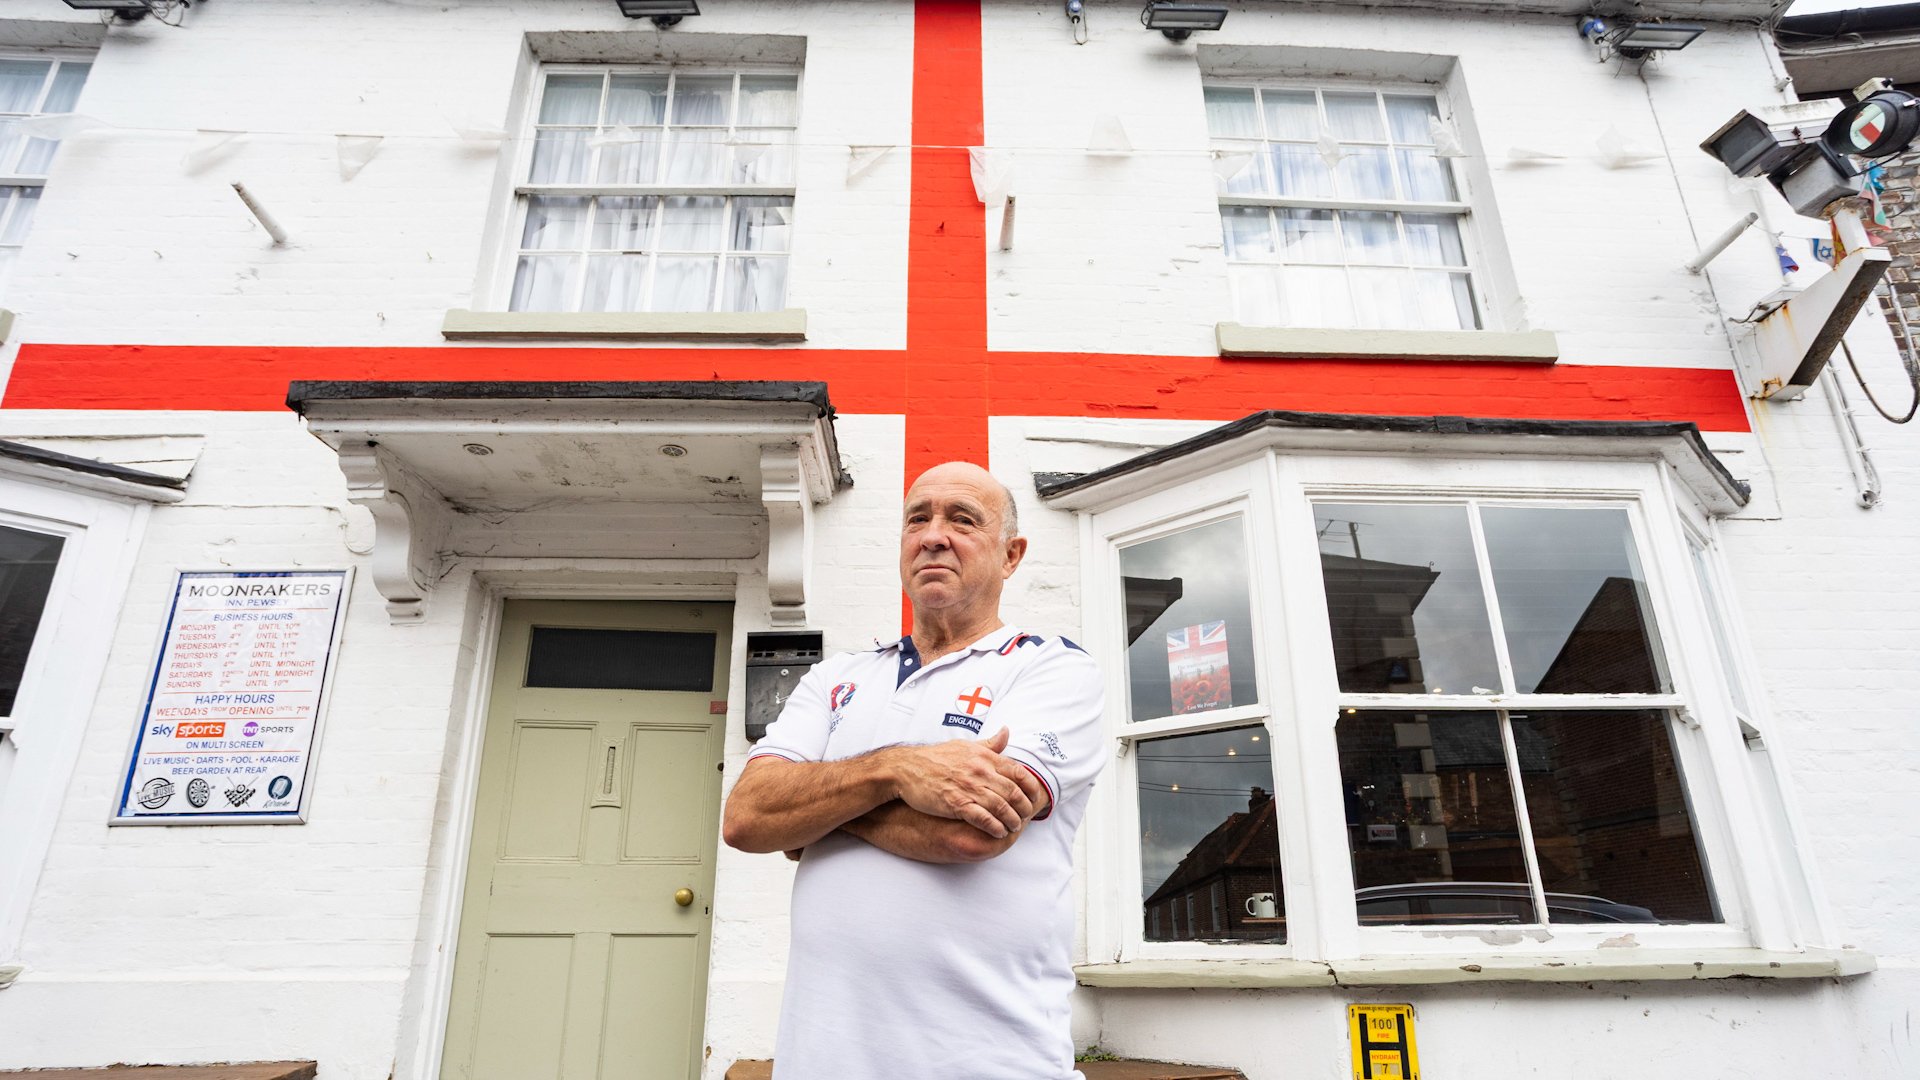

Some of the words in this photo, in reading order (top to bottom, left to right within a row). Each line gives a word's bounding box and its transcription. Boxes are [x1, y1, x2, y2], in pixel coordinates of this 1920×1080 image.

[189, 584, 331, 597] MOONRAKERS
[214, 613, 259, 621] BUSINESS
[261, 613, 293, 621] HOURS
[175, 642, 227, 650] WEDNESDAYS
[254, 641, 276, 649] UNTIL
[174, 652, 219, 660] THURSDAYS
[170, 661, 202, 669] FRIDAYS
[249, 660, 272, 668] UNTIL
[276, 660, 316, 668] MIDNIGHT
[168, 671, 214, 679] SATURDAYS
[247, 670, 270, 678] UNTIL
[166, 681, 202, 689] SUNDAYS
[195, 695, 232, 704] HAPPY
[234, 694, 275, 704] HOURS
[156, 708, 208, 716] WEEKDAYS
[229, 706, 274, 715] OPENING
[948, 715, 983, 730] ENGLAND
[152, 724, 174, 737] sky
[179, 724, 223, 737] sports
[186, 741, 199, 749] ON
[201, 741, 226, 749] MULTI
[196, 756, 224, 764] DARTS
[231, 756, 253, 764] POOL
[260, 755, 299, 763] KARAOKE
[172, 767, 194, 775] BEER
[1372, 1018, 1392, 1029] 100
[1382, 1063, 1388, 1074] 7
